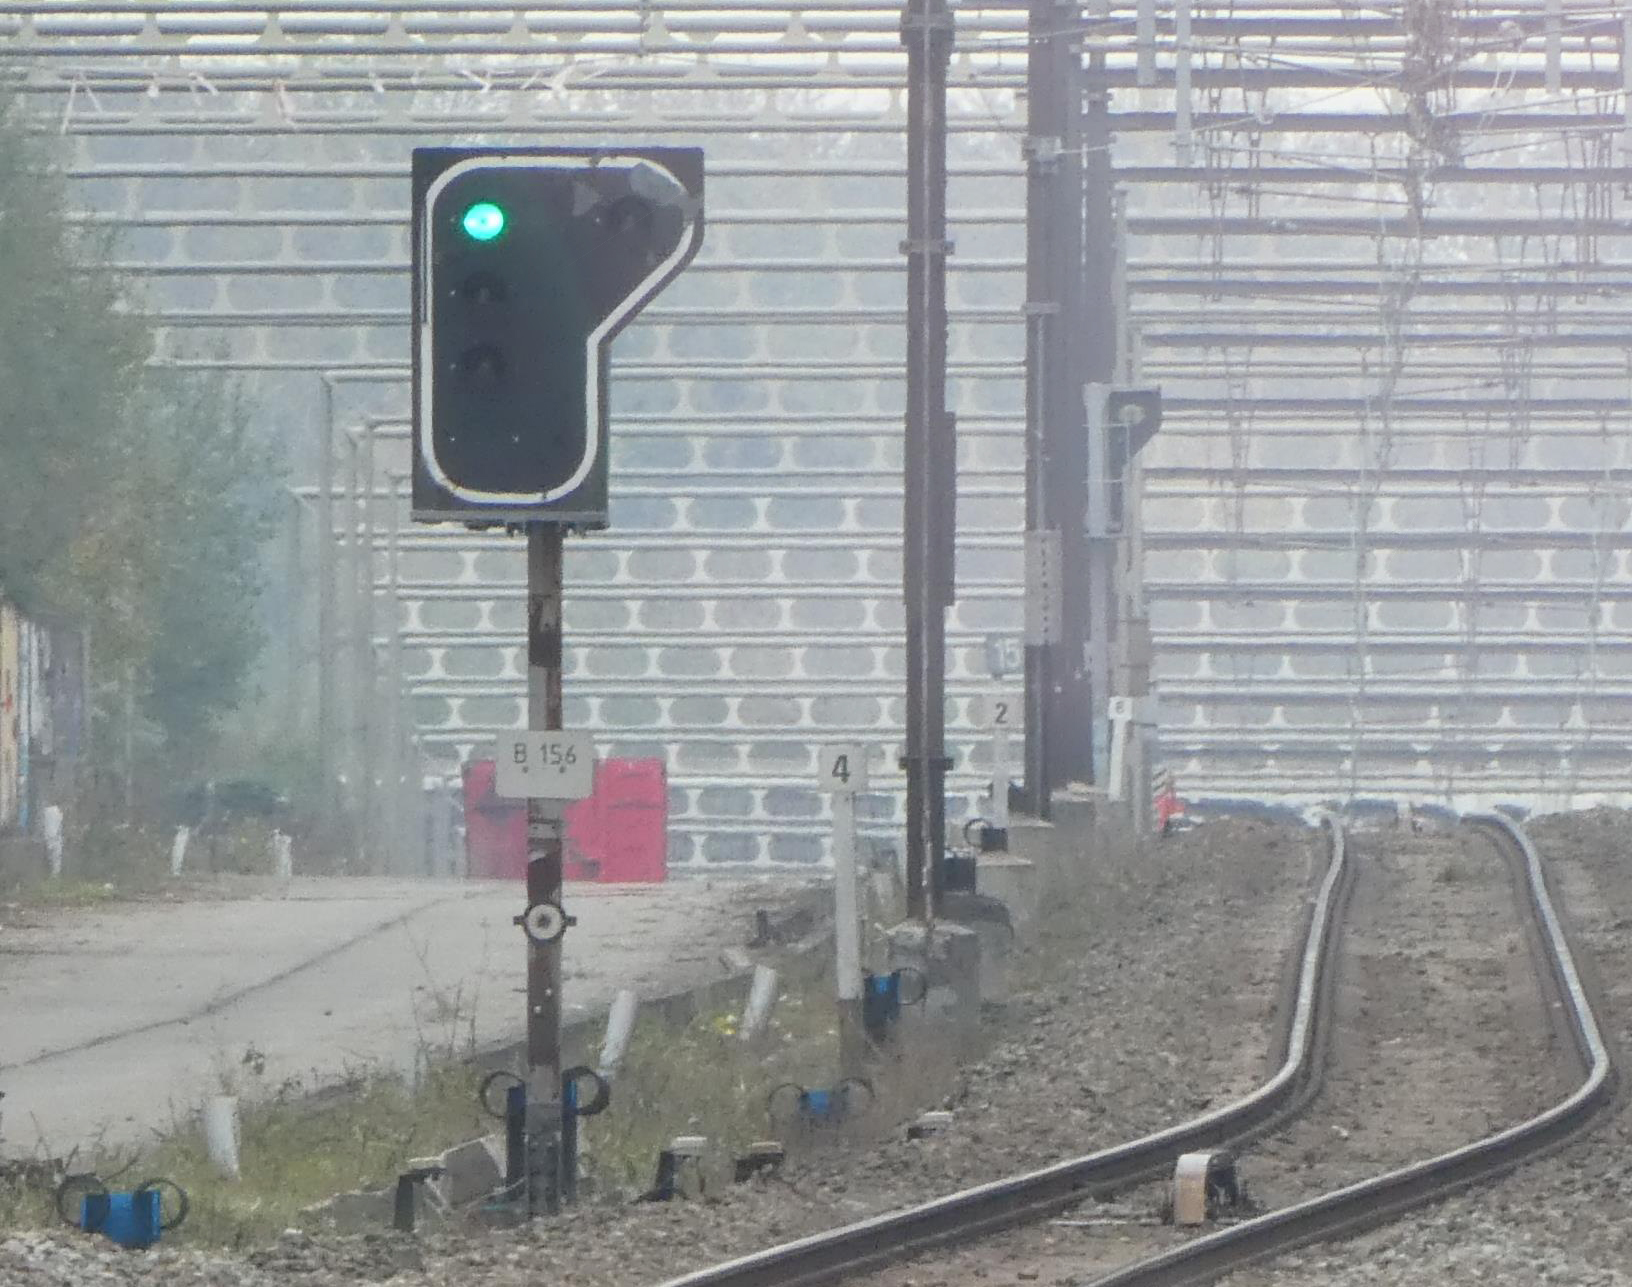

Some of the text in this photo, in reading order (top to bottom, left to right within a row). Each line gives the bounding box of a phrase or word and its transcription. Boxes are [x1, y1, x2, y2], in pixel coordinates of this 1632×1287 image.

[995, 702, 1008, 724] 2
[513, 742, 577, 765] B 156
[831, 754, 850, 784] 4
